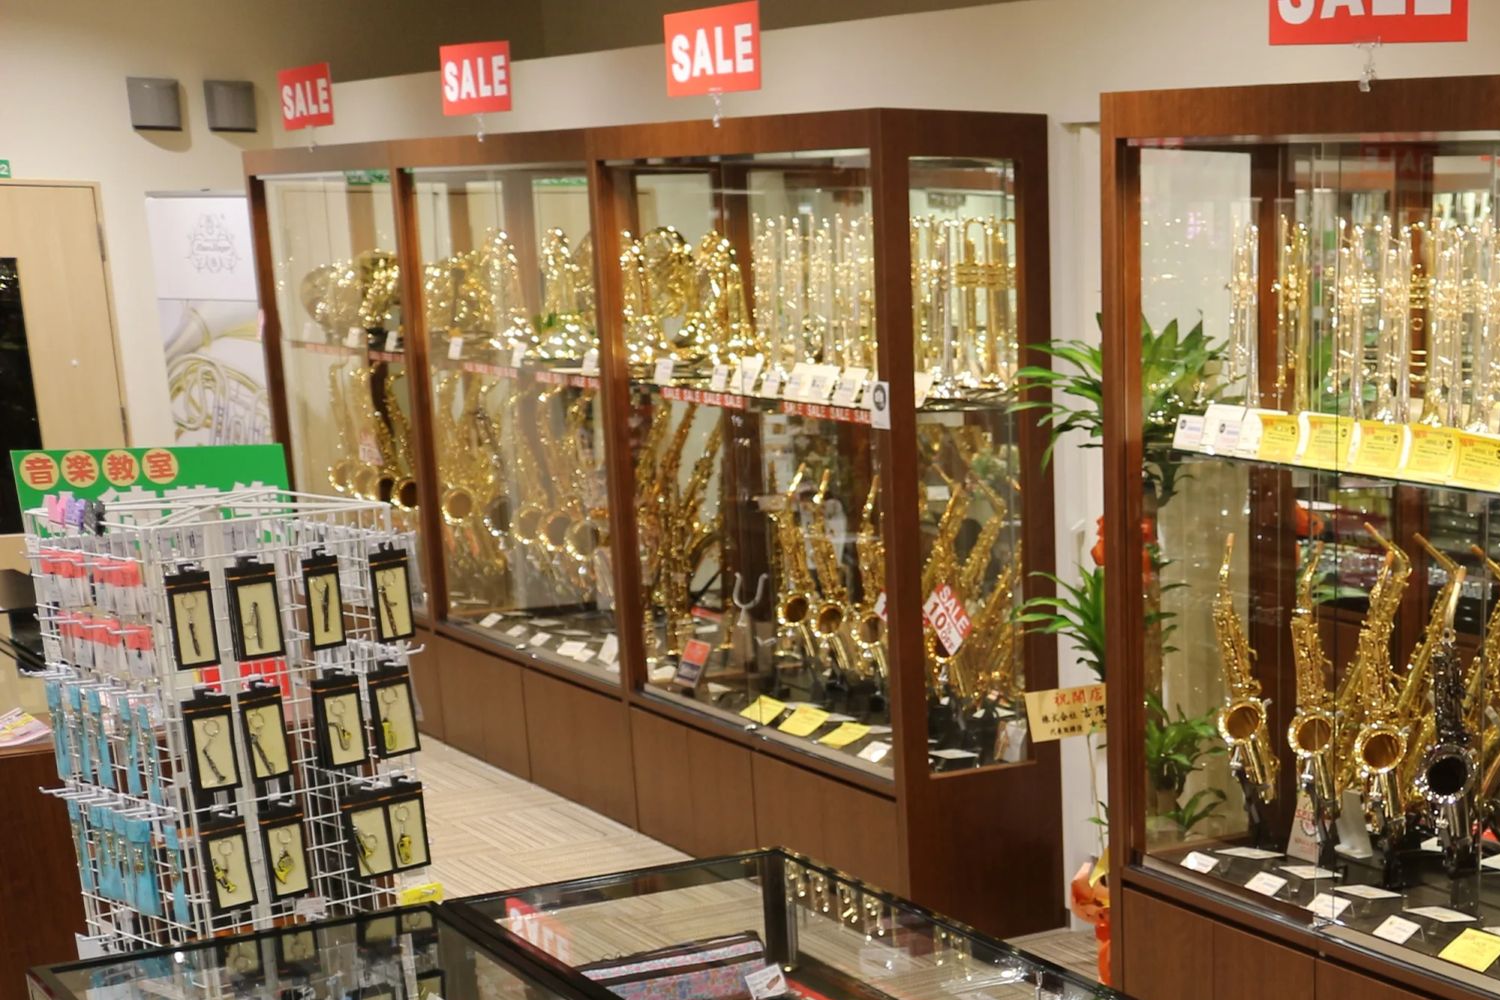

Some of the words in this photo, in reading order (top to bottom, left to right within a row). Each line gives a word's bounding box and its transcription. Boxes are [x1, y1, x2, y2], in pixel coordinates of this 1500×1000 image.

[672, 24, 753, 83] SALE
[282, 78, 330, 121] SALE
[444, 55, 508, 103] SALE
[25, 453, 175, 485] 音楽教室
[939, 585, 970, 634] SALE
